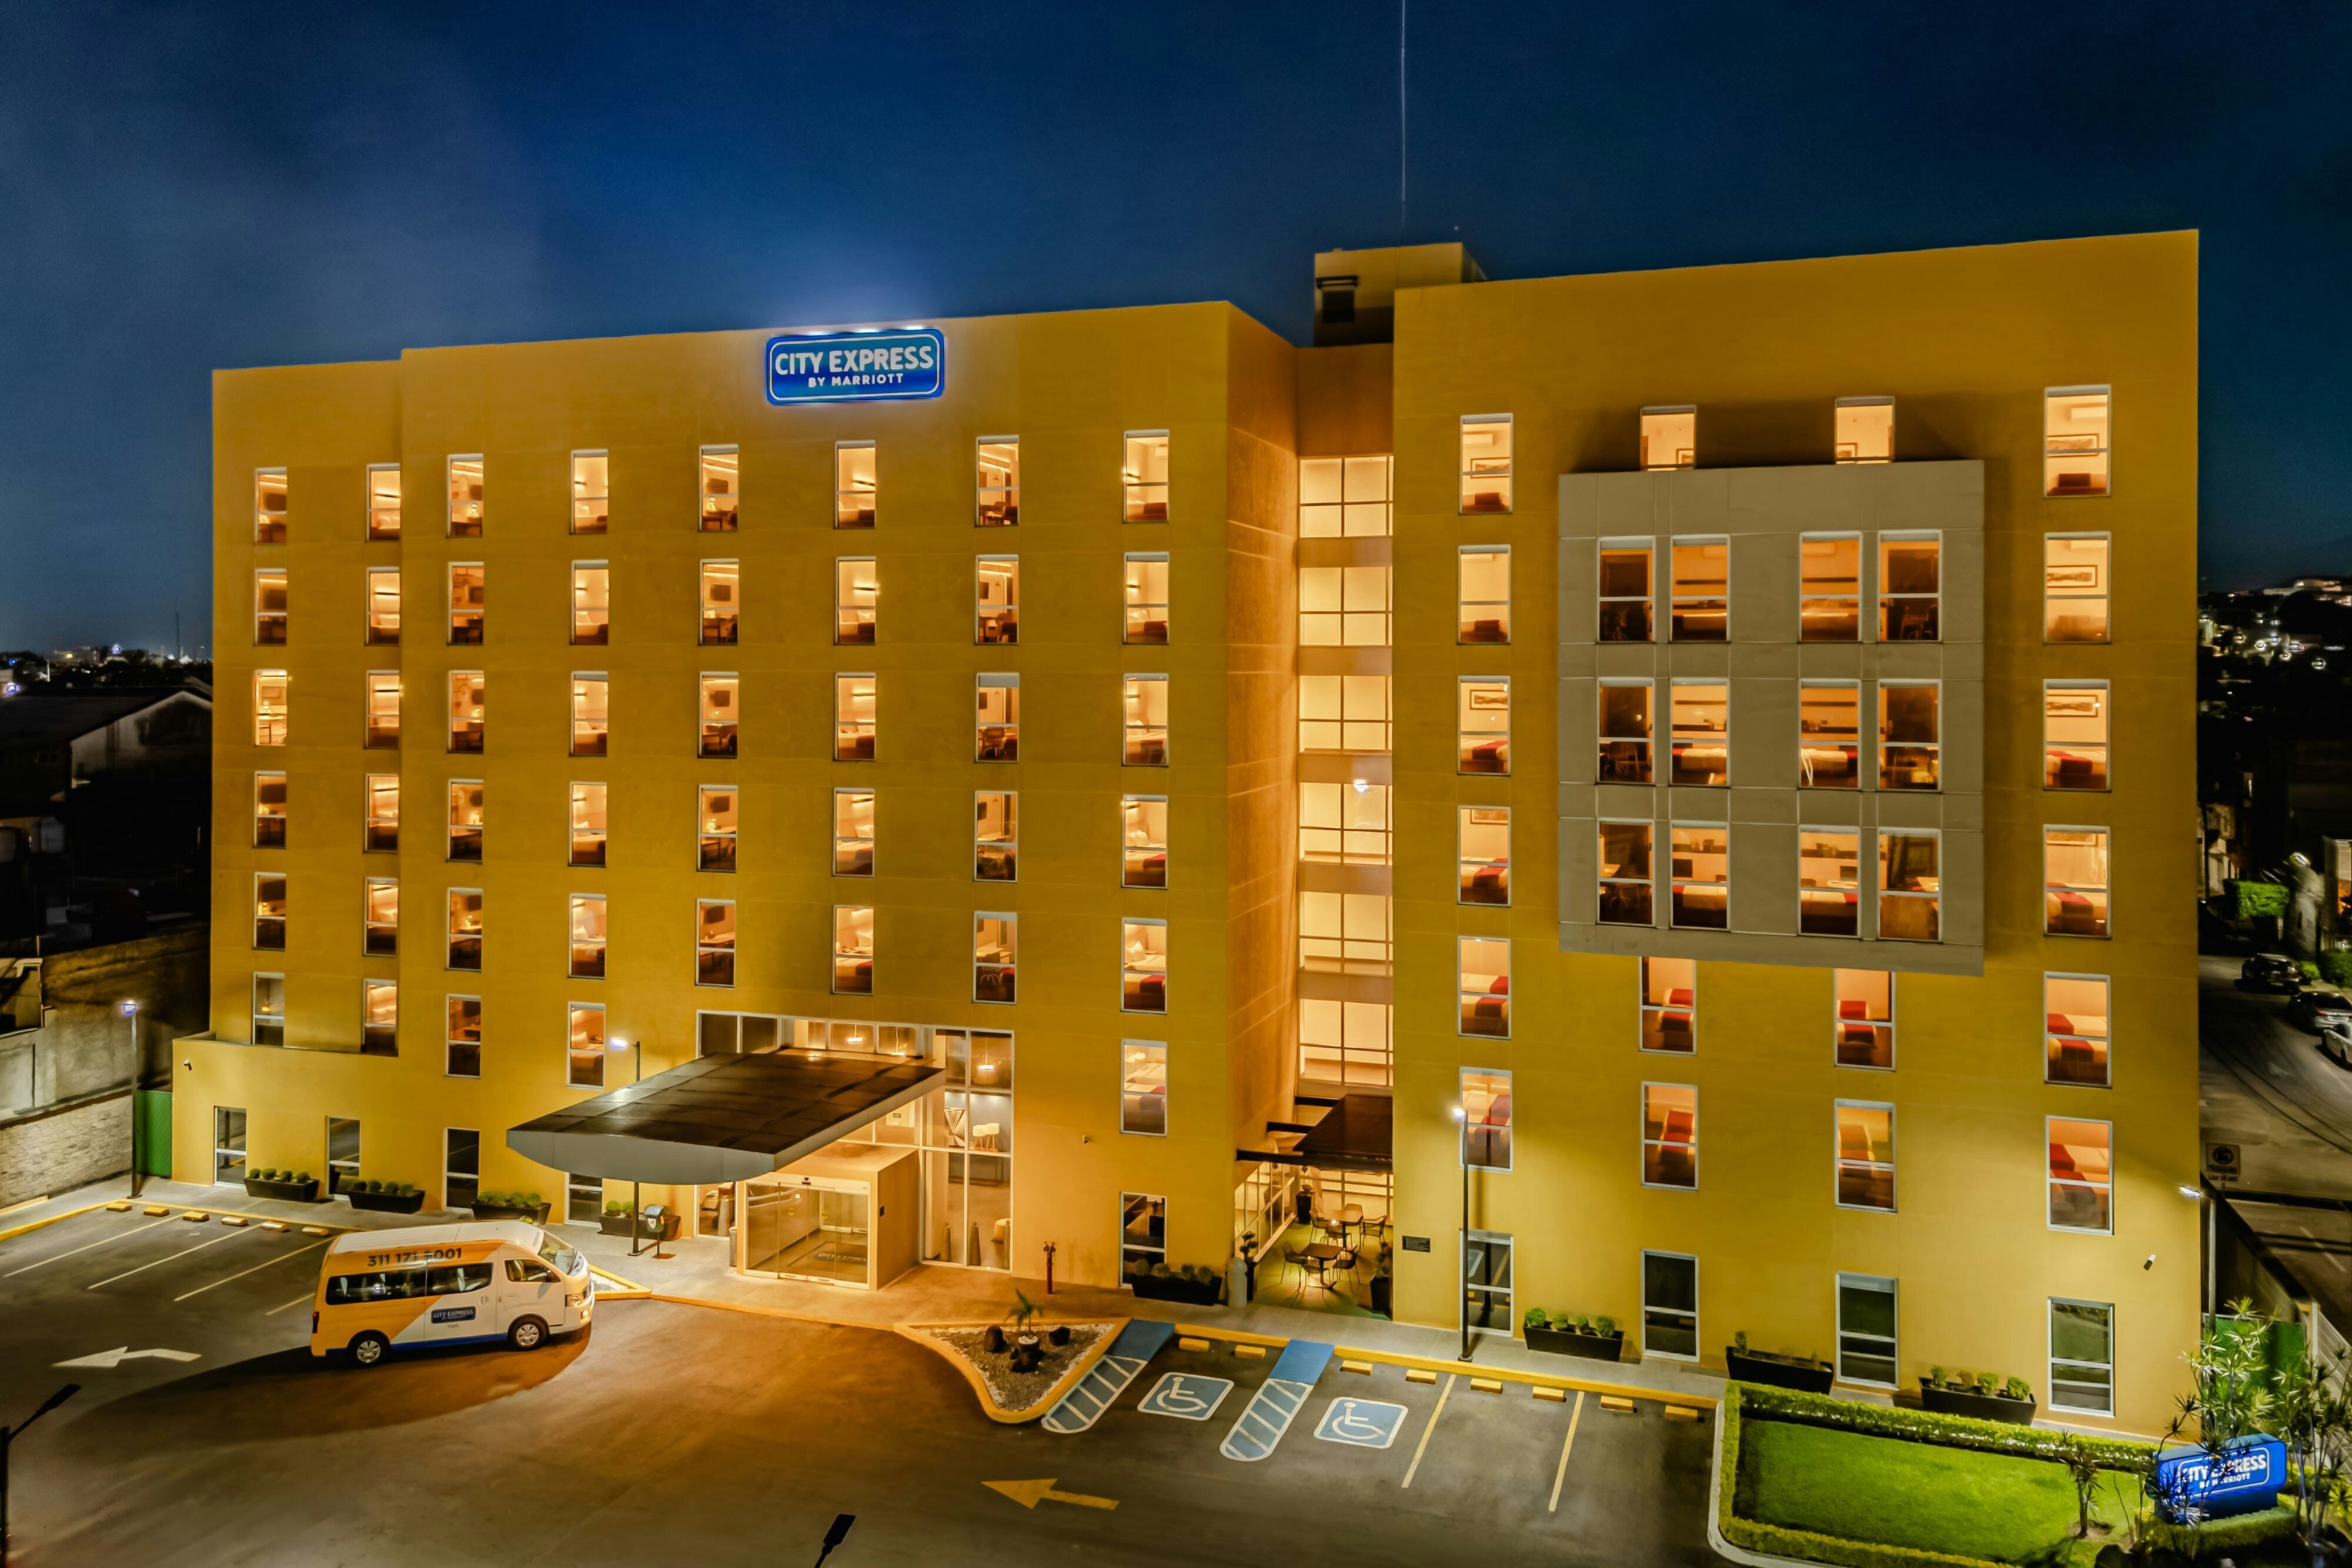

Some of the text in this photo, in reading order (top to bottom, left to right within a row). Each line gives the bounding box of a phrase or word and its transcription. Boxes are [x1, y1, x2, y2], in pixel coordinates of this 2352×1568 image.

[775, 346, 933, 375] CITY EXPRESS
[808, 373, 904, 387] BY MARRIOTT
[368, 1253, 390, 1267] 311
[447, 1309, 473, 1317] EXPRESS
[2212, 1472, 2250, 1486] MRRIOTT
